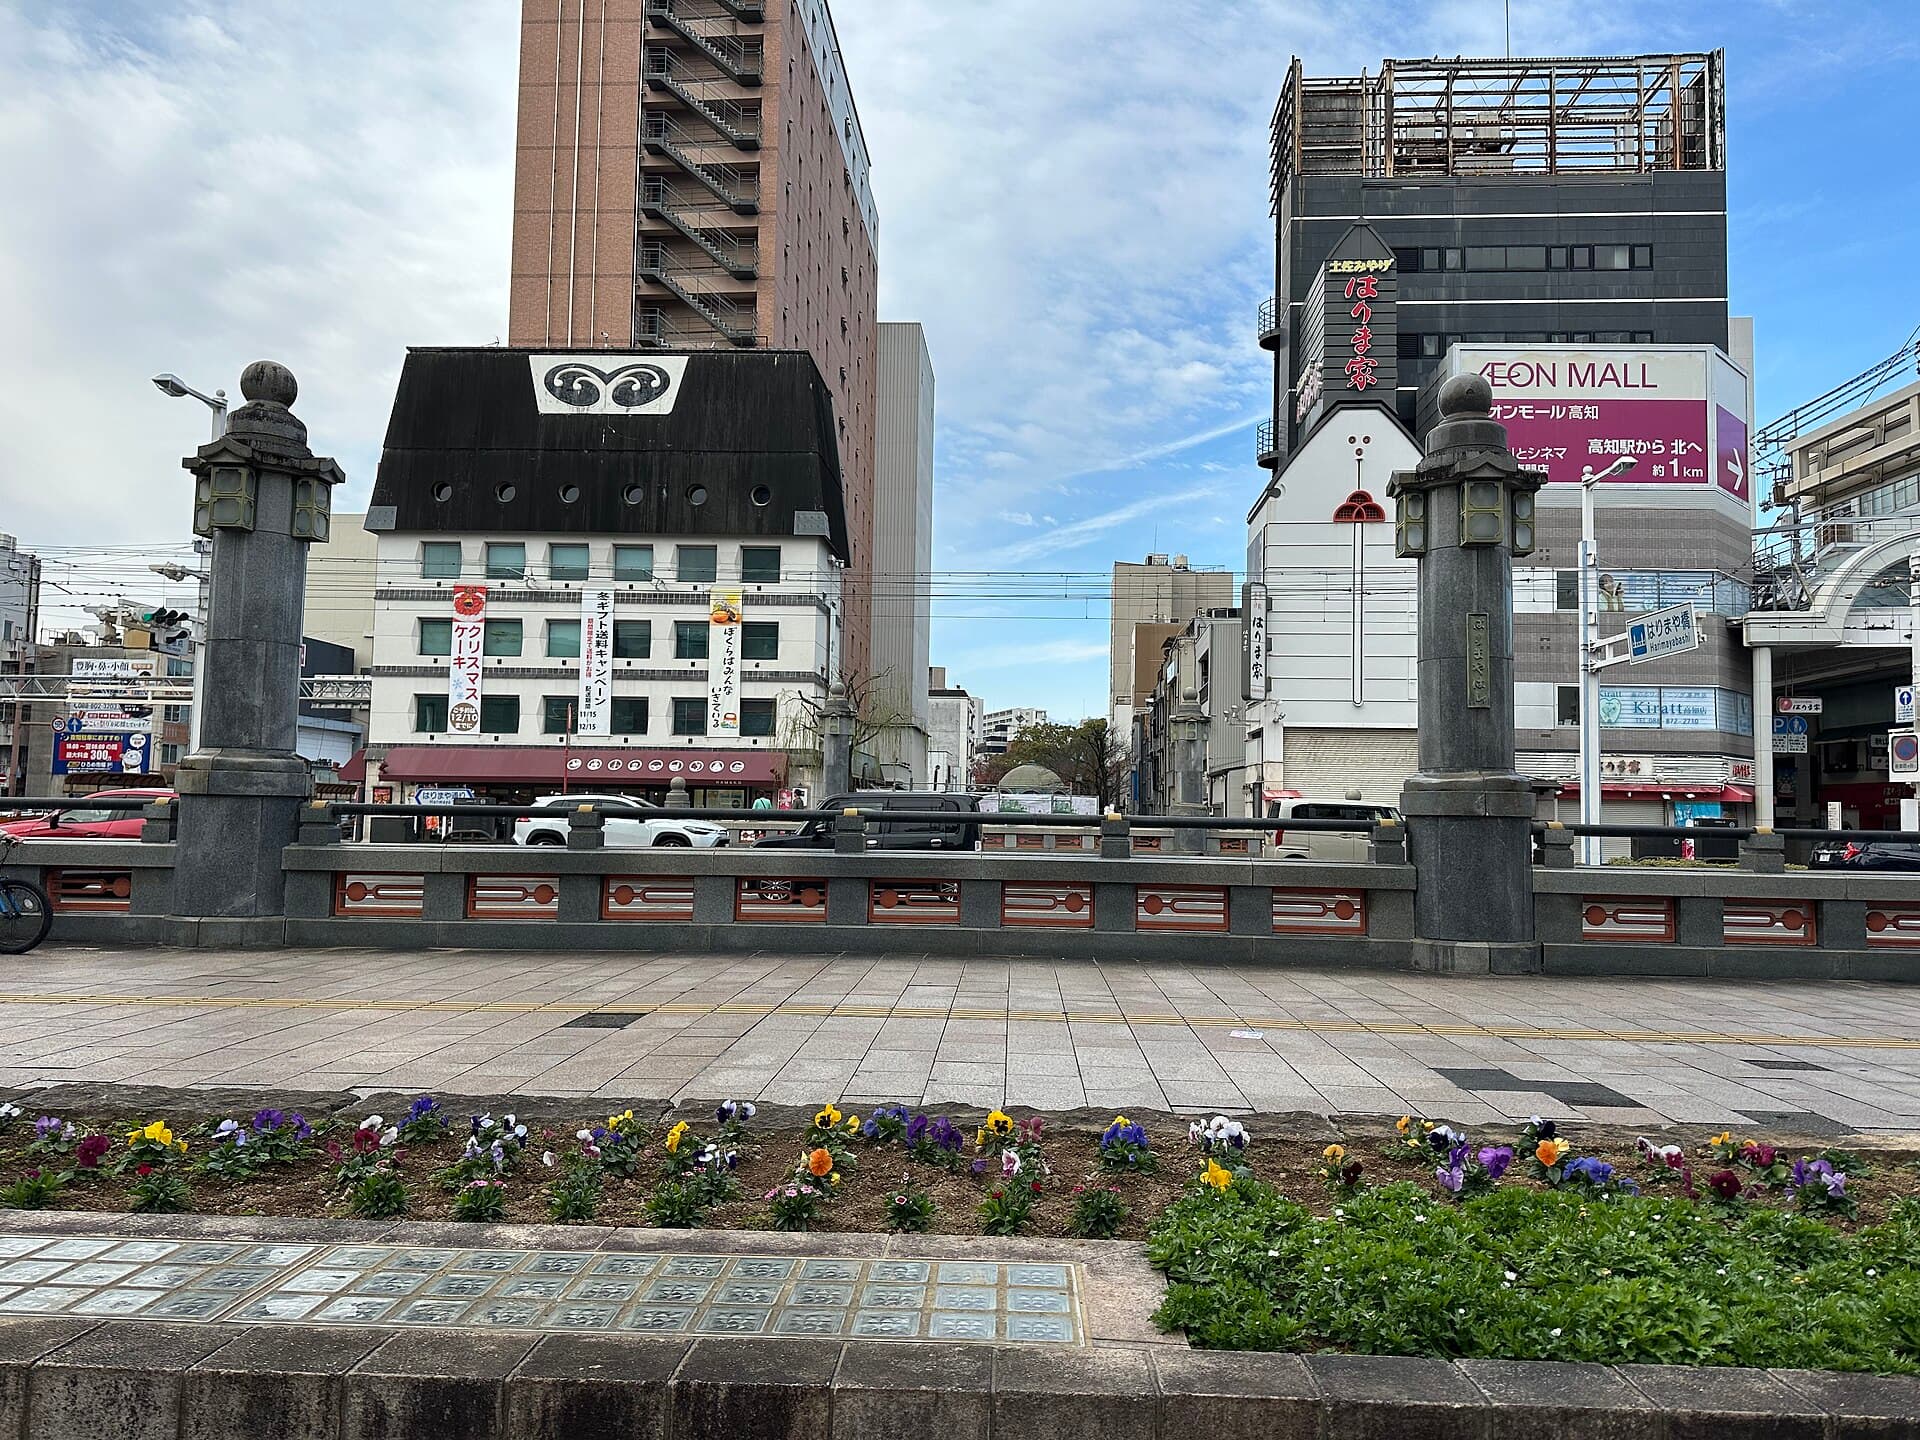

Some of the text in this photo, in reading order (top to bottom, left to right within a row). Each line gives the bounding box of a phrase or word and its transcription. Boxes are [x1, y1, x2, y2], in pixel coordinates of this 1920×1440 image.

[1329, 259, 1393, 273] 土佐みやげ
[1345, 275, 1378, 391] はりま家
[1568, 363, 1657, 388] MALL
[1490, 405, 1599, 420] オンモール高知
[1587, 438, 1702, 455] 高知駅から 北へ
[1652, 464, 1664, 477] 約
[1646, 610, 1691, 641] はりまや橋
[453, 624, 468, 669] ケーキ
[594, 591, 610, 706] 冬ギフト送料キャンペーン
[1252, 616, 1264, 681] はりま家
[1650, 632, 1691, 654] Harimayabashi
[466, 625, 481, 700] クリスマス
[723, 626, 738, 696] ぼくらはみんな
[450, 713, 479, 723] 12/10
[711, 687, 722, 729] いきている
[578, 723, 597, 731] 12/15
